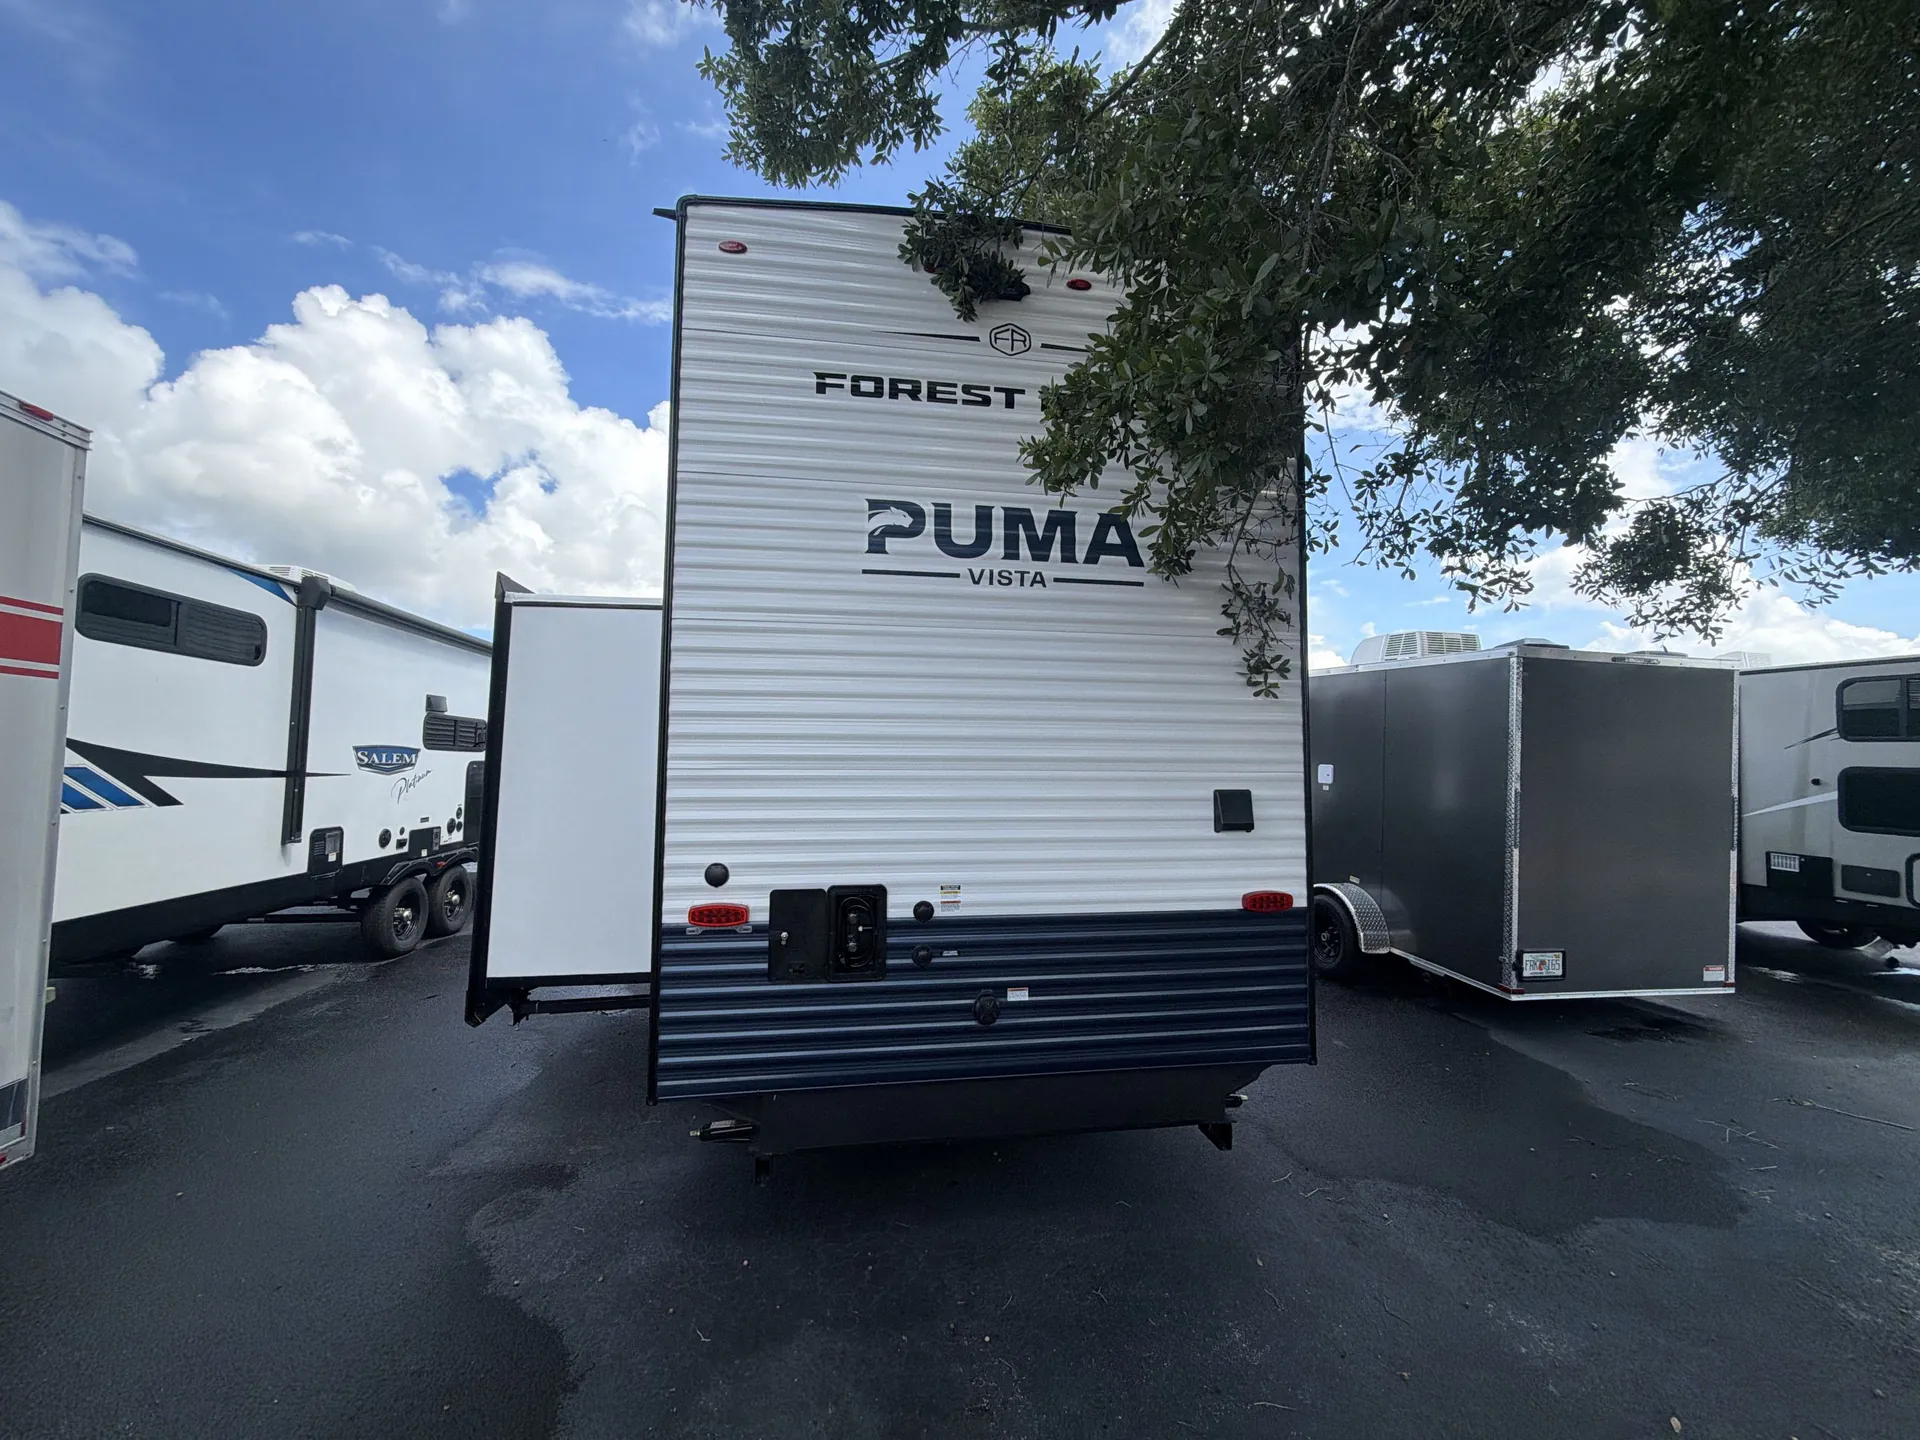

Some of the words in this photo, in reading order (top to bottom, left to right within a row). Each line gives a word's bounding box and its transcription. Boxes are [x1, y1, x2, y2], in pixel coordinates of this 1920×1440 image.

[812, 371, 1026, 409] FOREST
[864, 498, 1145, 568] PUMA
[967, 567, 1047, 588] VISTA
[357, 751, 417, 765] SALEM
